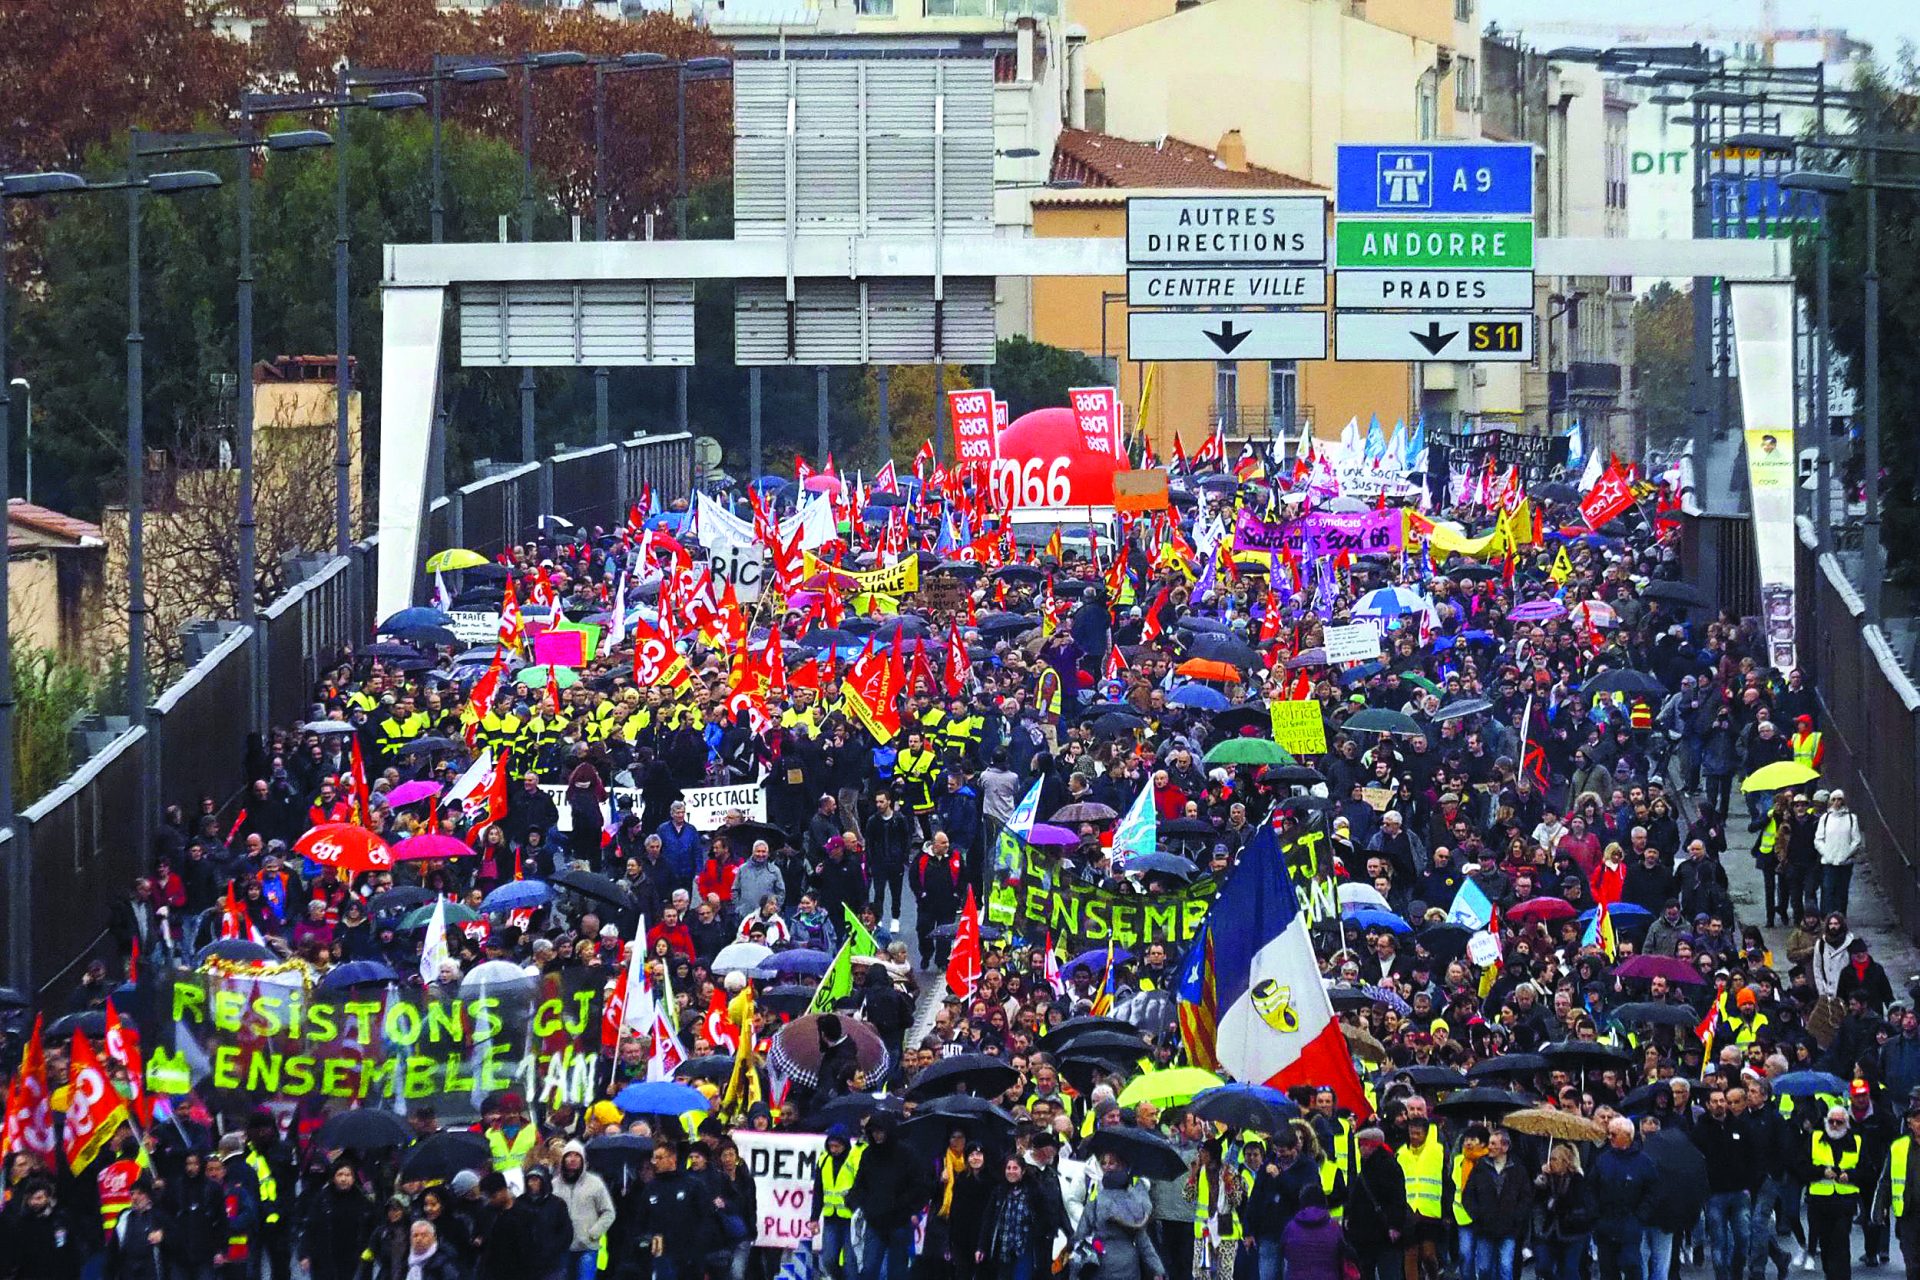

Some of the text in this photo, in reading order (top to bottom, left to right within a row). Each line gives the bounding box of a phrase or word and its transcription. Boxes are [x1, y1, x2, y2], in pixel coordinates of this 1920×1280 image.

[1631, 151, 1688, 175] DIT
[1178, 208, 1276, 226] AUTRES
[1148, 233, 1305, 252] DIRECTIONS
[1361, 232, 1507, 257] ANDORRE
[1147, 277, 1306, 297] CENTRE VILLE
[1382, 280, 1487, 299] PRADES
[1318, 515, 1362, 530] syndicats
[1369, 526, 1390, 548] 66
[693, 787, 759, 807] SPECTACLE
[311, 841, 344, 862] cgt
[368, 845, 391, 865] cg
[1026, 888, 1210, 943] ENSEMB
[213, 1044, 512, 1100] ENSEMBLE
[751, 1149, 817, 1180] DEM
[764, 1217, 817, 1238] PLUS
